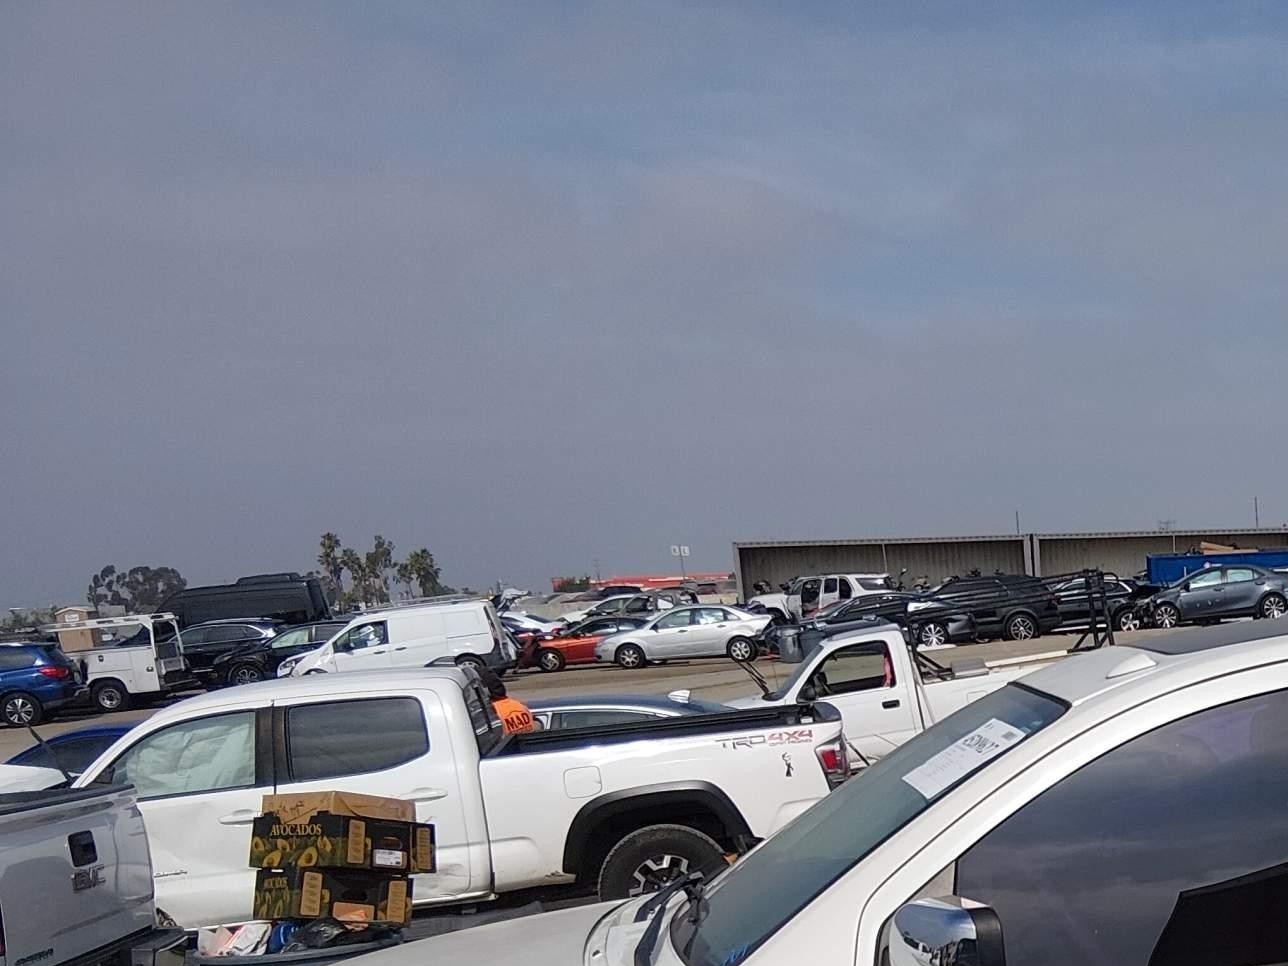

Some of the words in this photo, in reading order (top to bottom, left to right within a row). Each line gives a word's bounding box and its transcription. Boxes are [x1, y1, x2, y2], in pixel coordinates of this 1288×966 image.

[504, 712, 530, 731] MAD
[715, 735, 766, 749] TRD
[270, 823, 322, 836] AVOCADOS
